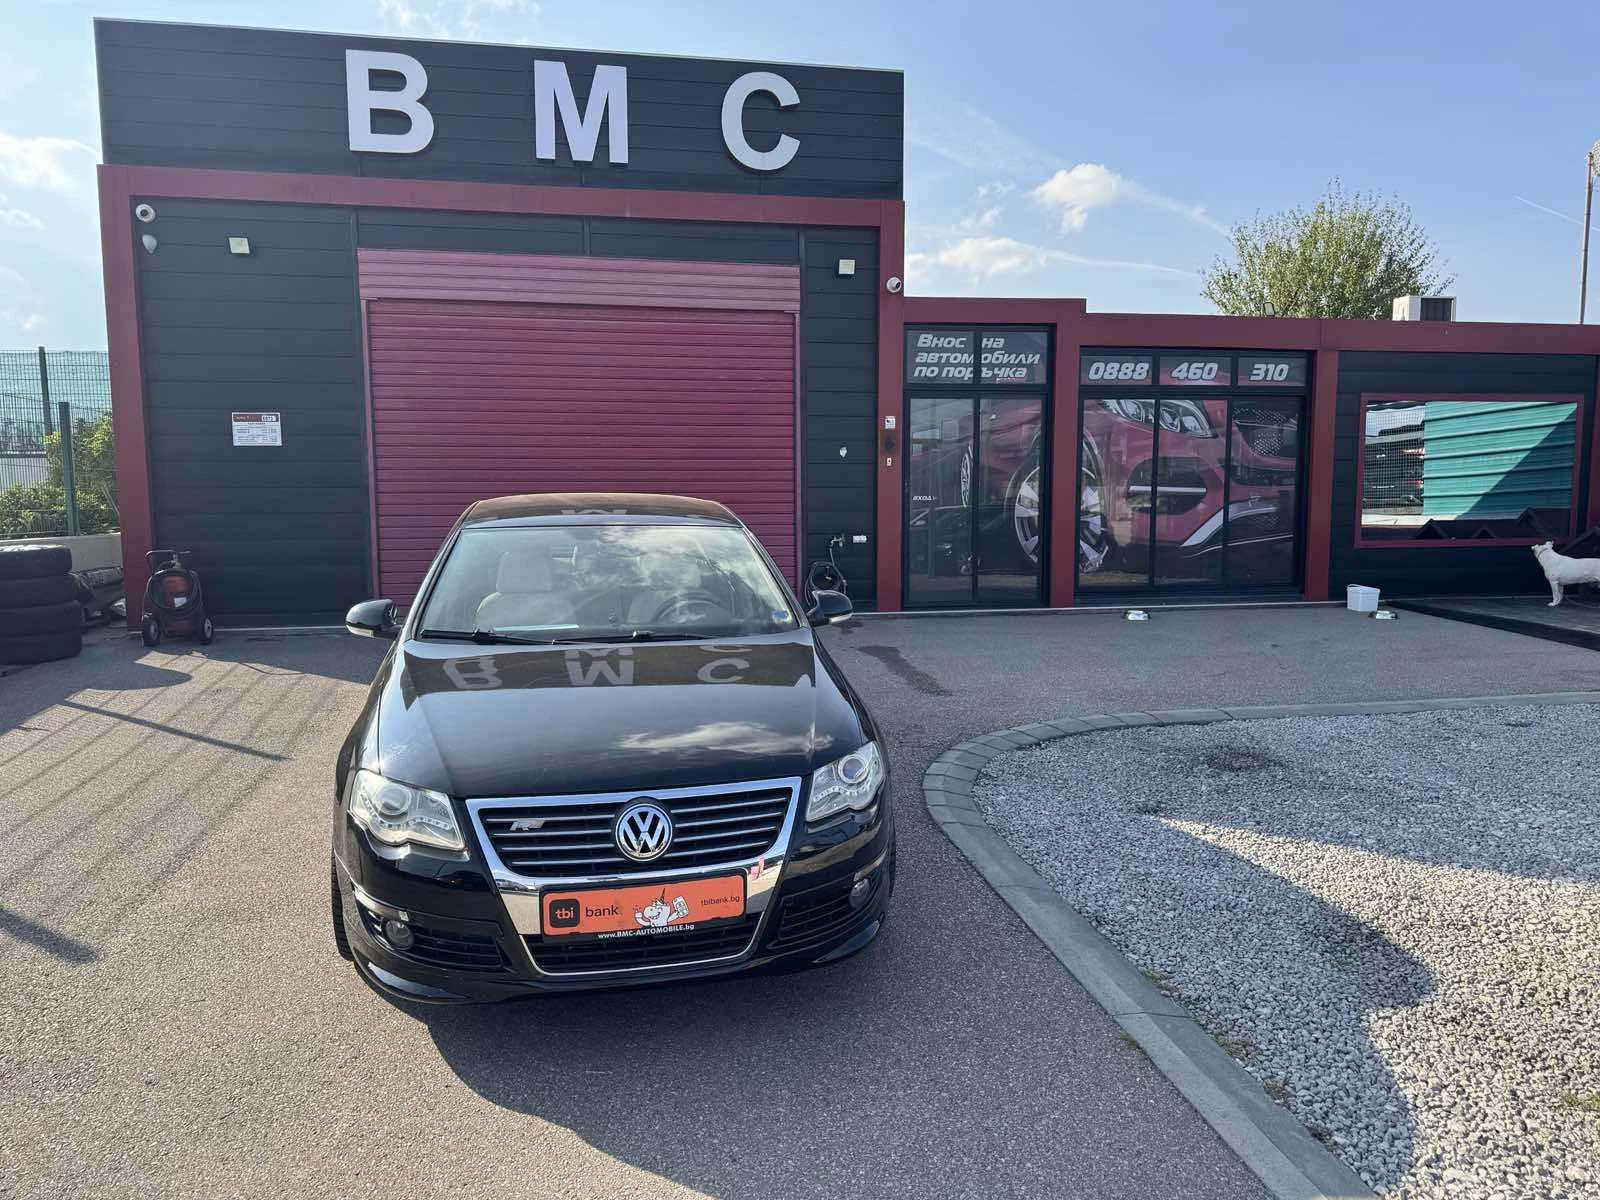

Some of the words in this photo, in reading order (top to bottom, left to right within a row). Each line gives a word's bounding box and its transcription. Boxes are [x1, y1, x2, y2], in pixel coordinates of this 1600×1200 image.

[917, 334, 967, 348] Внос
[981, 337, 1005, 348] на
[915, 350, 1041, 364] автомобили
[914, 366, 939, 377] по
[1088, 362, 1149, 380] 0888
[1171, 362, 1218, 380] 460
[1250, 363, 1289, 381] 310
[555, 907, 574, 919] tbi
[585, 904, 620, 918] bank
[598, 923, 695, 939] www.BMC-AUTOMOBILE.bg
